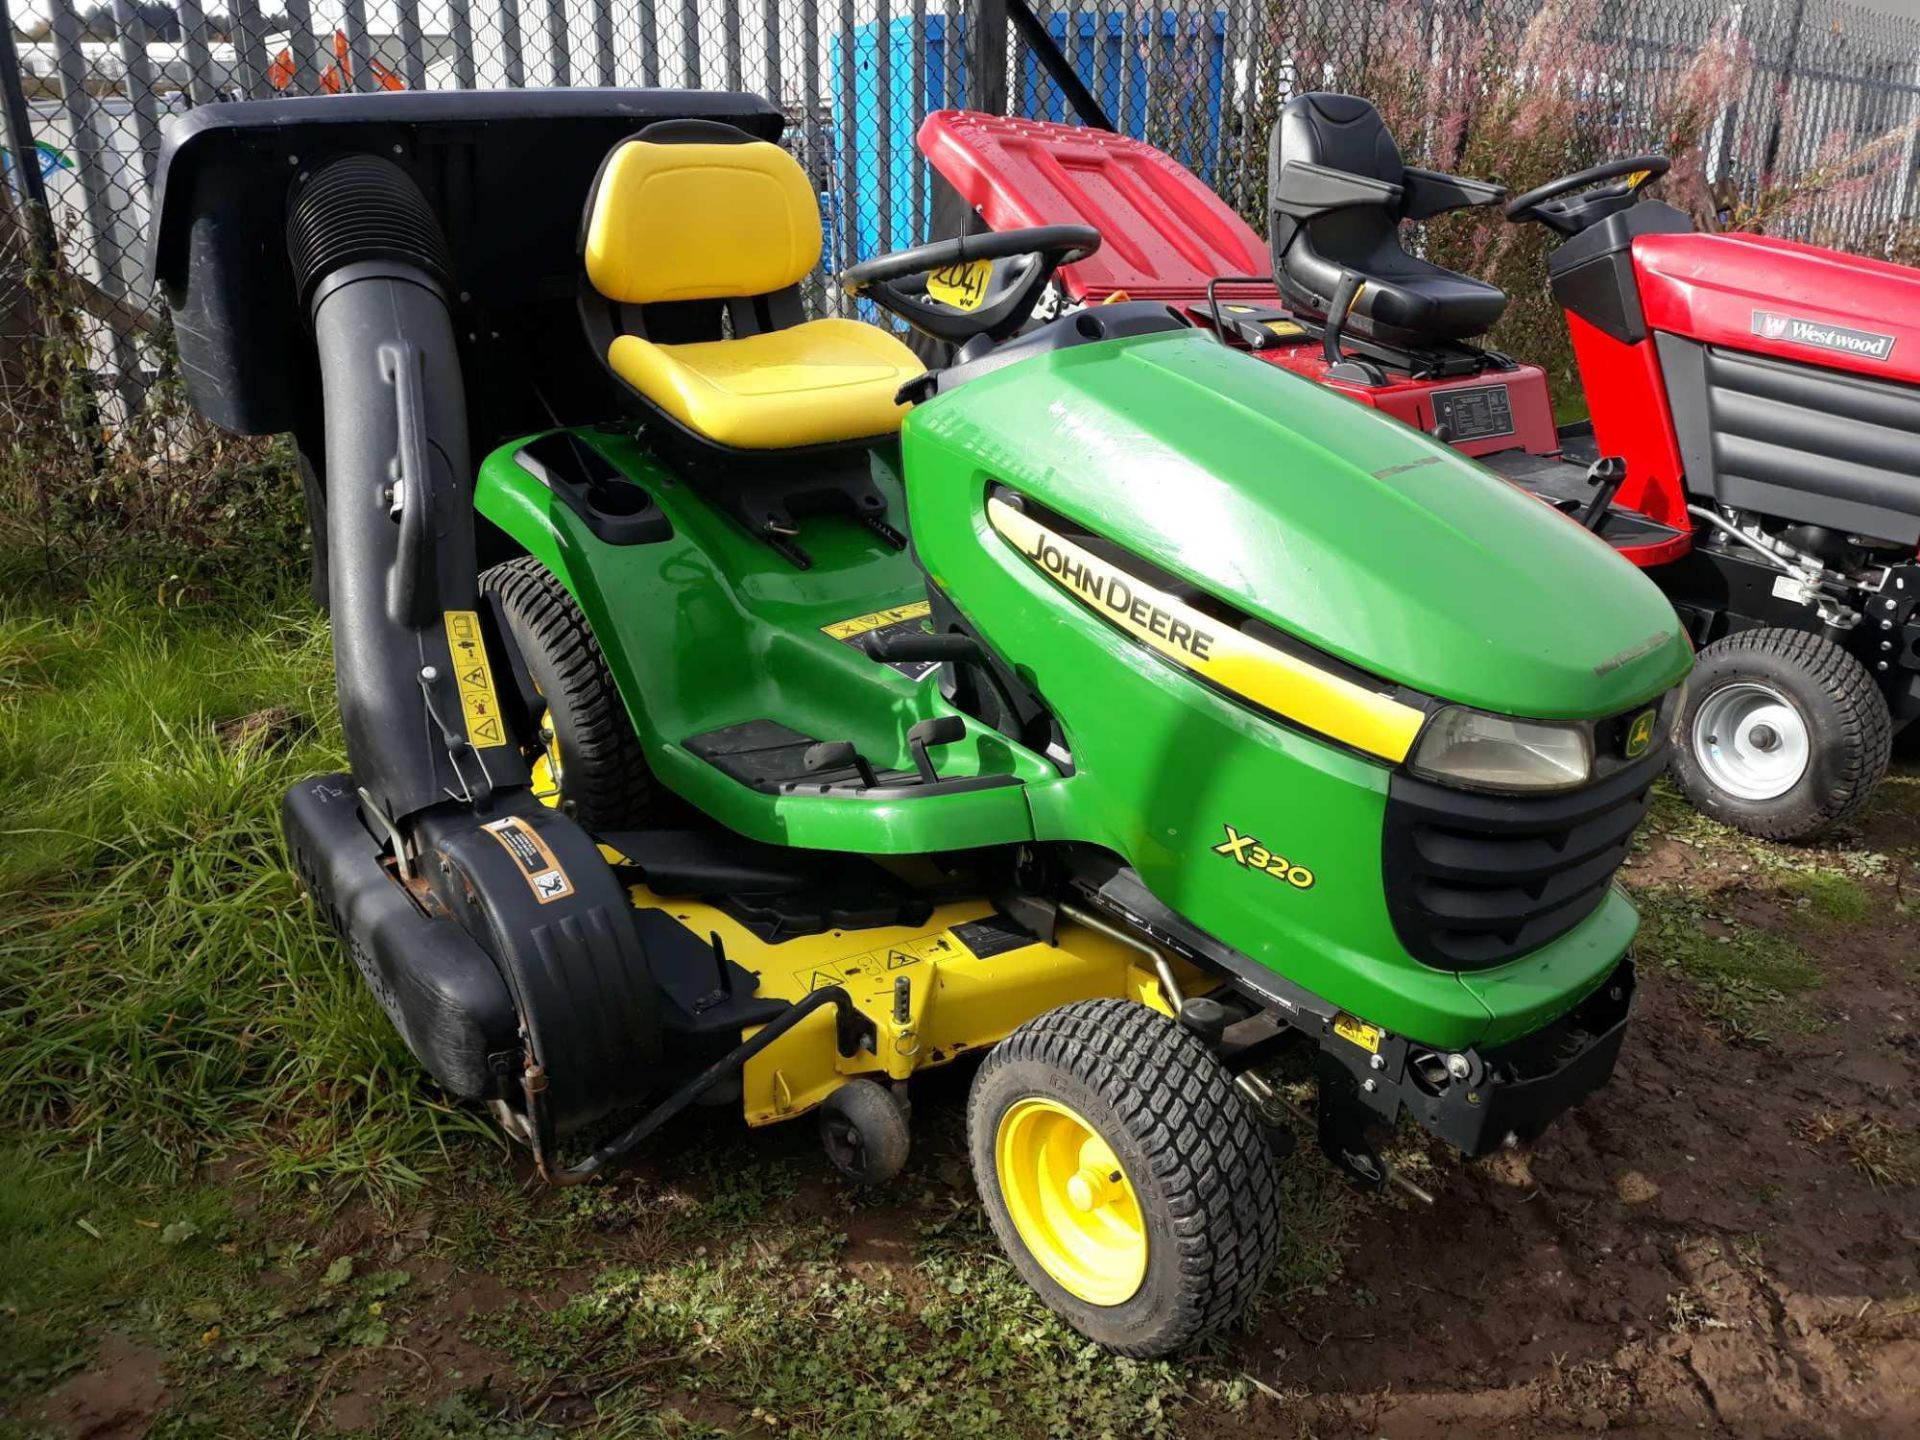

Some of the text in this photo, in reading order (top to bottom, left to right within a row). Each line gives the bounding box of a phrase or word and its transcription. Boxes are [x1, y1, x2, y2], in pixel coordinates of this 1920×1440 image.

[1792, 321, 1886, 354] Westwood
[1027, 534, 1214, 662] JOHN DEERE
[1211, 823, 1315, 889] X320
